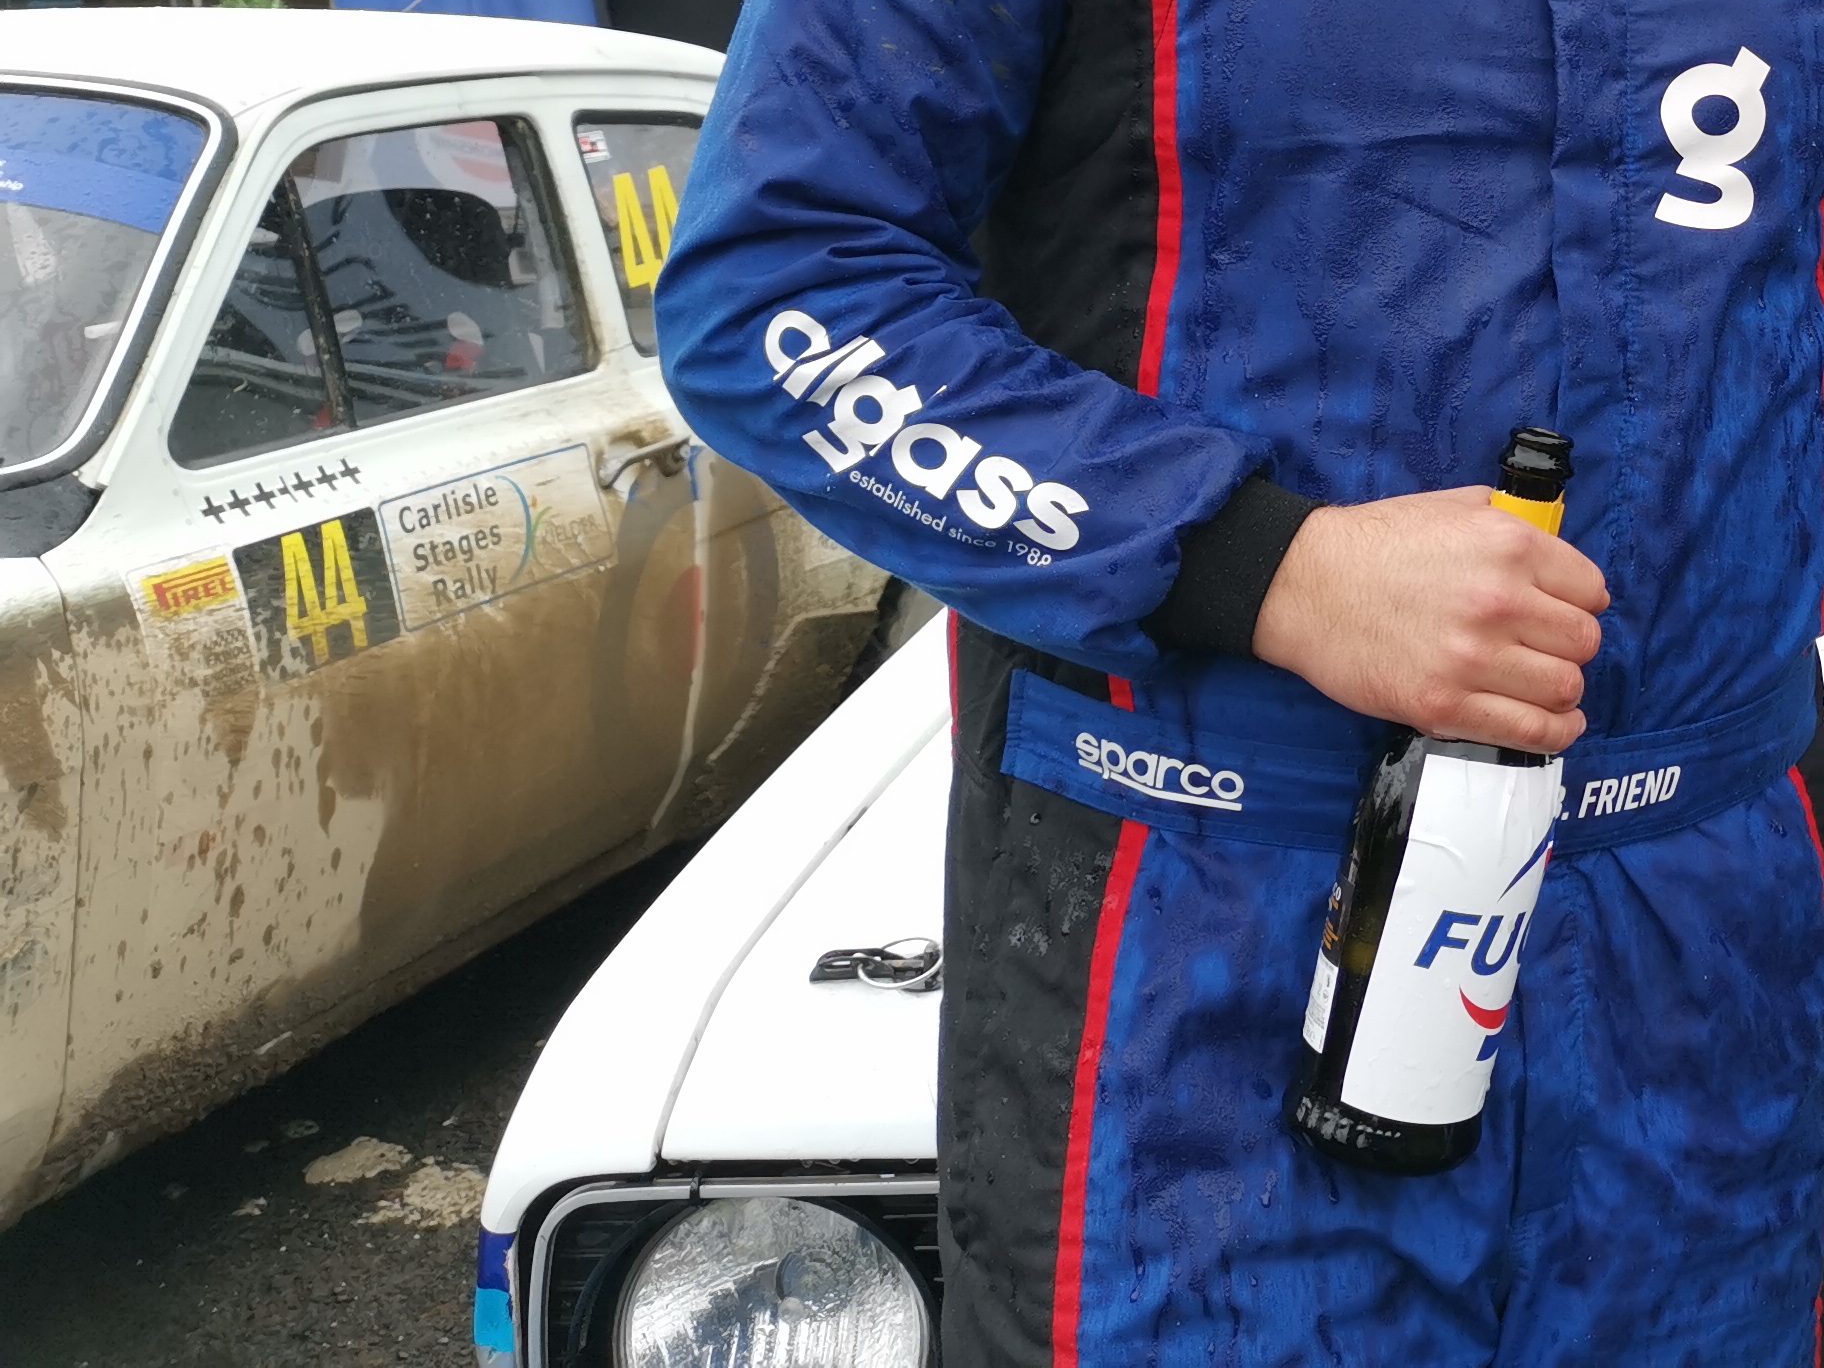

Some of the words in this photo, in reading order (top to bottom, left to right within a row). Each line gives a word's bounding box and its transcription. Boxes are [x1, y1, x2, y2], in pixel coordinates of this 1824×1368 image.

[1654, 46, 1771, 230] g
[765, 309, 1090, 551] allgass
[399, 481, 499, 536] Carlisle
[850, 469, 946, 532] established
[948, 526, 997, 548] since
[412, 521, 502, 572] Stages
[152, 563, 235, 611] PIREL
[281, 519, 368, 664] 44
[431, 561, 499, 608] Rally
[1075, 732, 1245, 804] sparco
[1577, 765, 1681, 819] FRIEND
